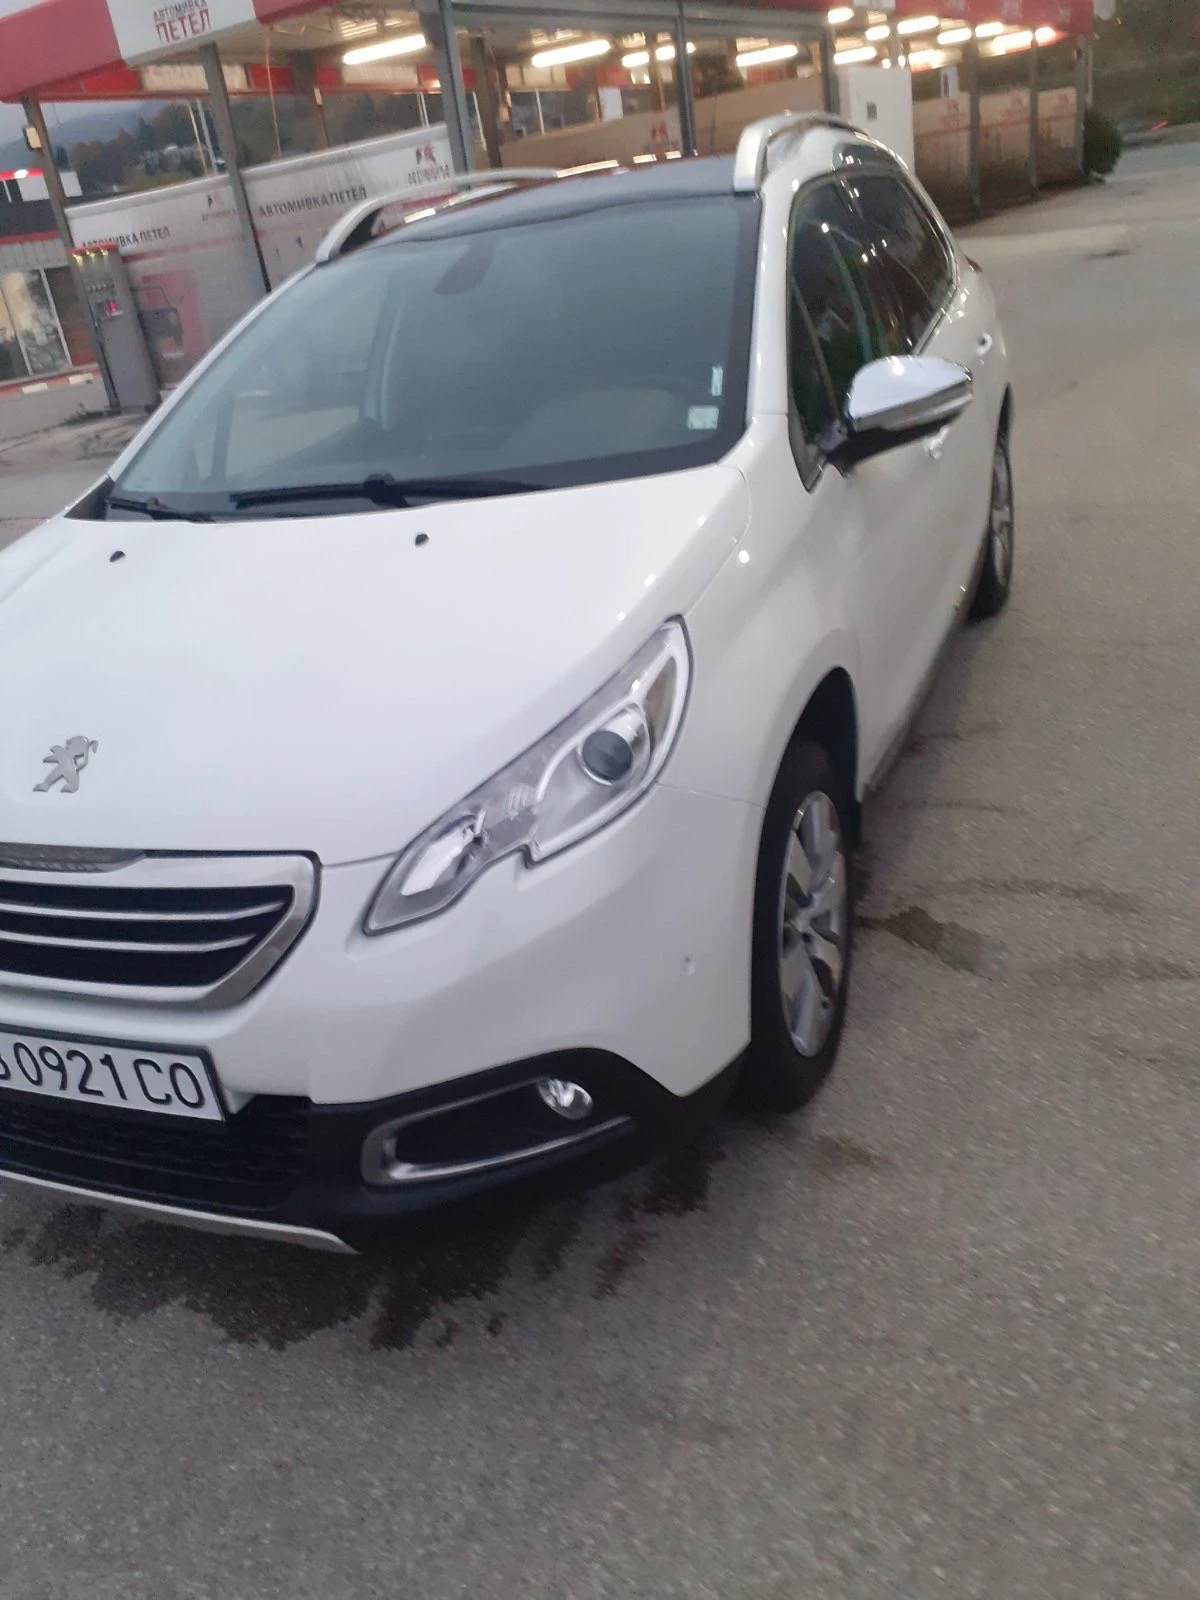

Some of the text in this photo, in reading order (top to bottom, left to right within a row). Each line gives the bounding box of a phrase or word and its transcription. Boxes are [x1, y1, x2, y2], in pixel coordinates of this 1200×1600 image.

[155, 8, 211, 44] ПЕТЕЛ
[259, 194, 329, 218] АВТОМИВКА
[330, 184, 368, 206] ПЕТЕЛ
[140, 226, 171, 243] ПЕТЕЛ
[13, 1041, 128, 1101] 0921
